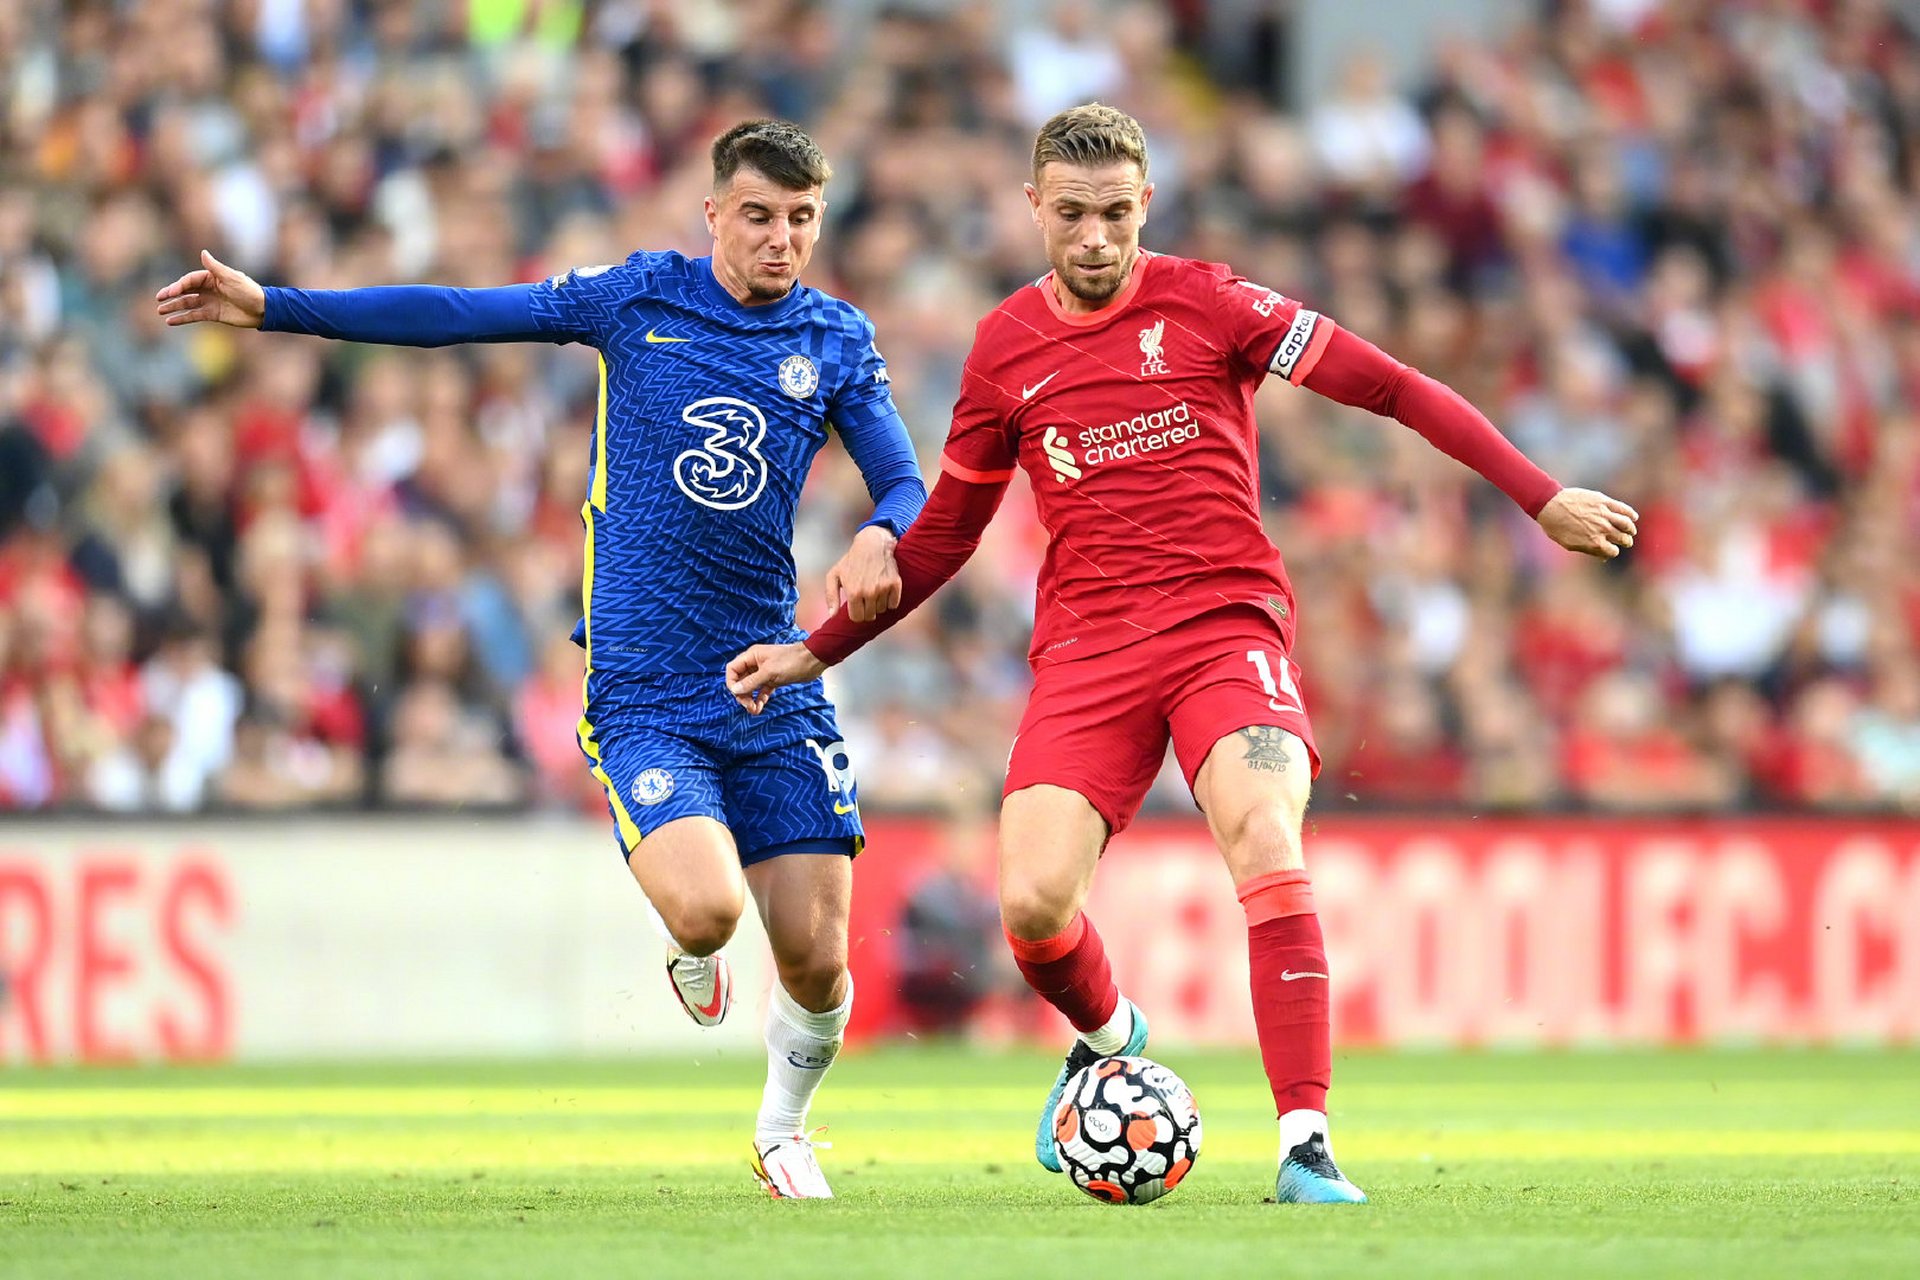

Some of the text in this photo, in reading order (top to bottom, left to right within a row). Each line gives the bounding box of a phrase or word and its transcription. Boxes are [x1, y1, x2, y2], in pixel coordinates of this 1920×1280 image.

[1079, 401, 1190, 448] standard
[1085, 419, 1200, 465] chartered
[673, 397, 768, 510] 3
